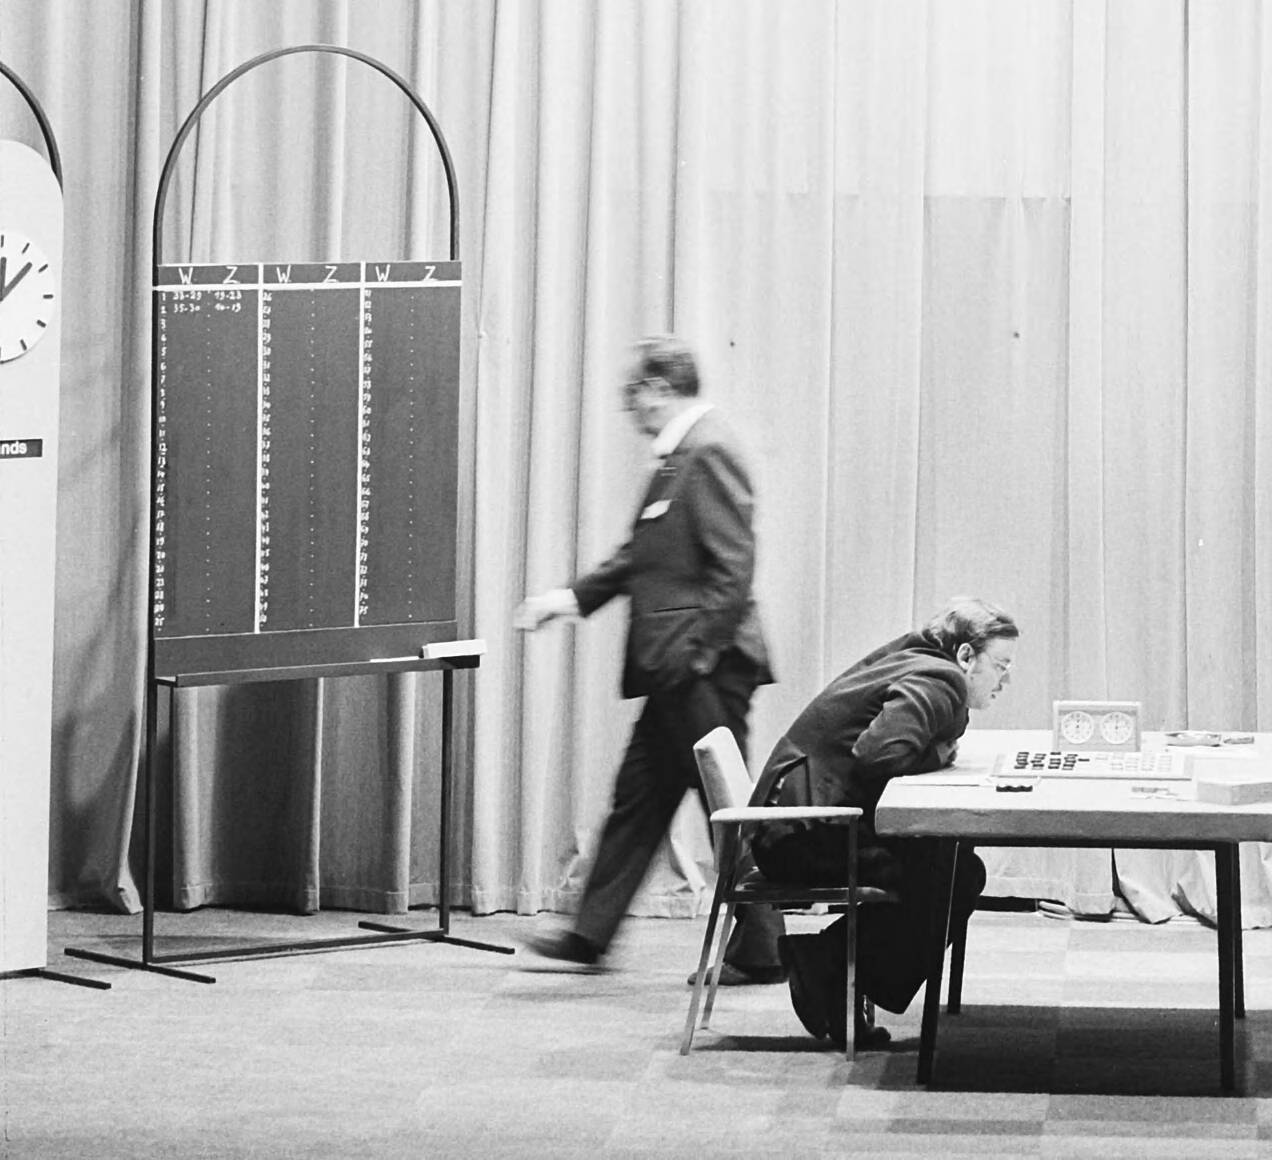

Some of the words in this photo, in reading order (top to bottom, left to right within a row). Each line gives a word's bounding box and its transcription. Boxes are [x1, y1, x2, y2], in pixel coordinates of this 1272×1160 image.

[178, 267, 194, 285] W
[222, 266, 241, 284] Z
[276, 264, 292, 283] W
[322, 265, 339, 283] Z
[375, 264, 391, 282] W
[423, 265, 439, 282] Z
